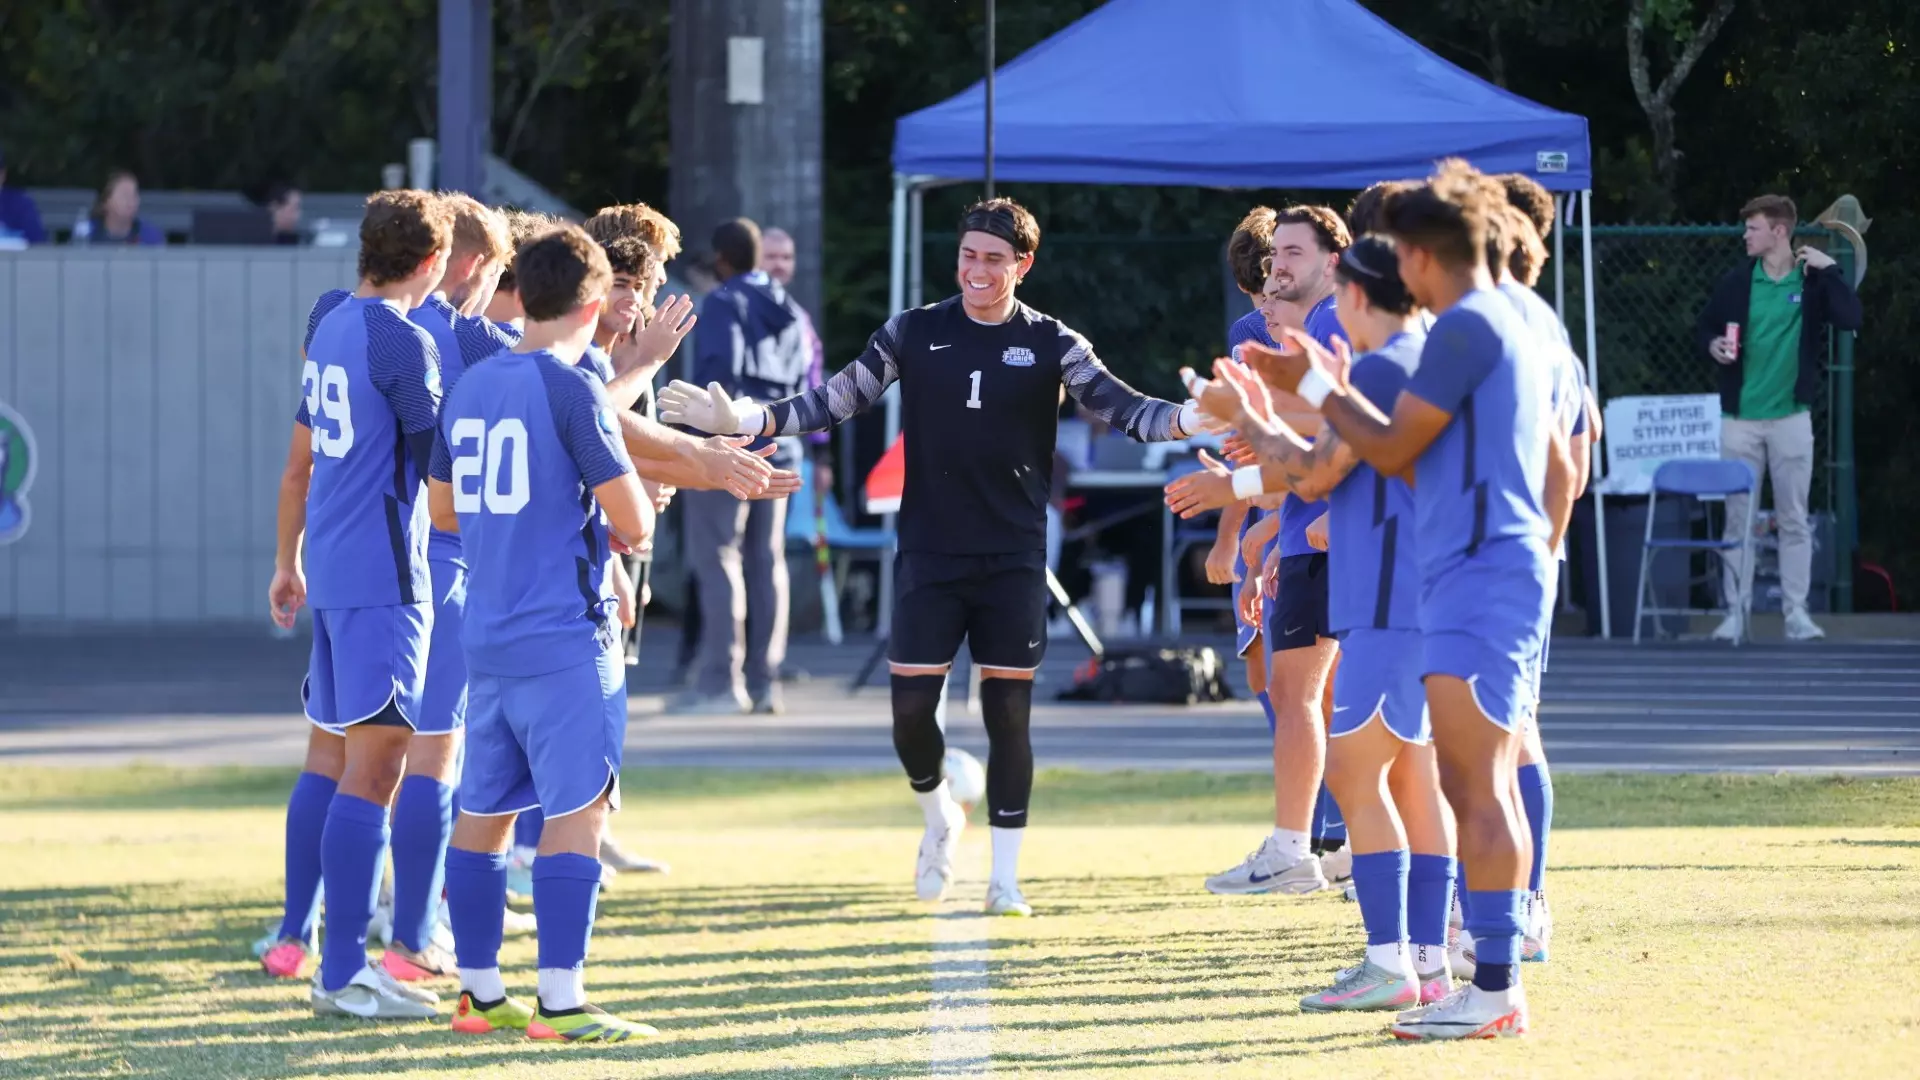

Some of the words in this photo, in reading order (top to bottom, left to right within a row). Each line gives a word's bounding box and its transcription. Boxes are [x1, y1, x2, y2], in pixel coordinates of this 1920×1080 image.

[966, 369, 982, 409] 1
[1637, 405, 1705, 424] PLEASE
[1632, 424, 1677, 441] STAY
[1680, 421, 1713, 438] OFF
[1615, 442, 1684, 461] SOCCER
[451, 418, 531, 515] 20
